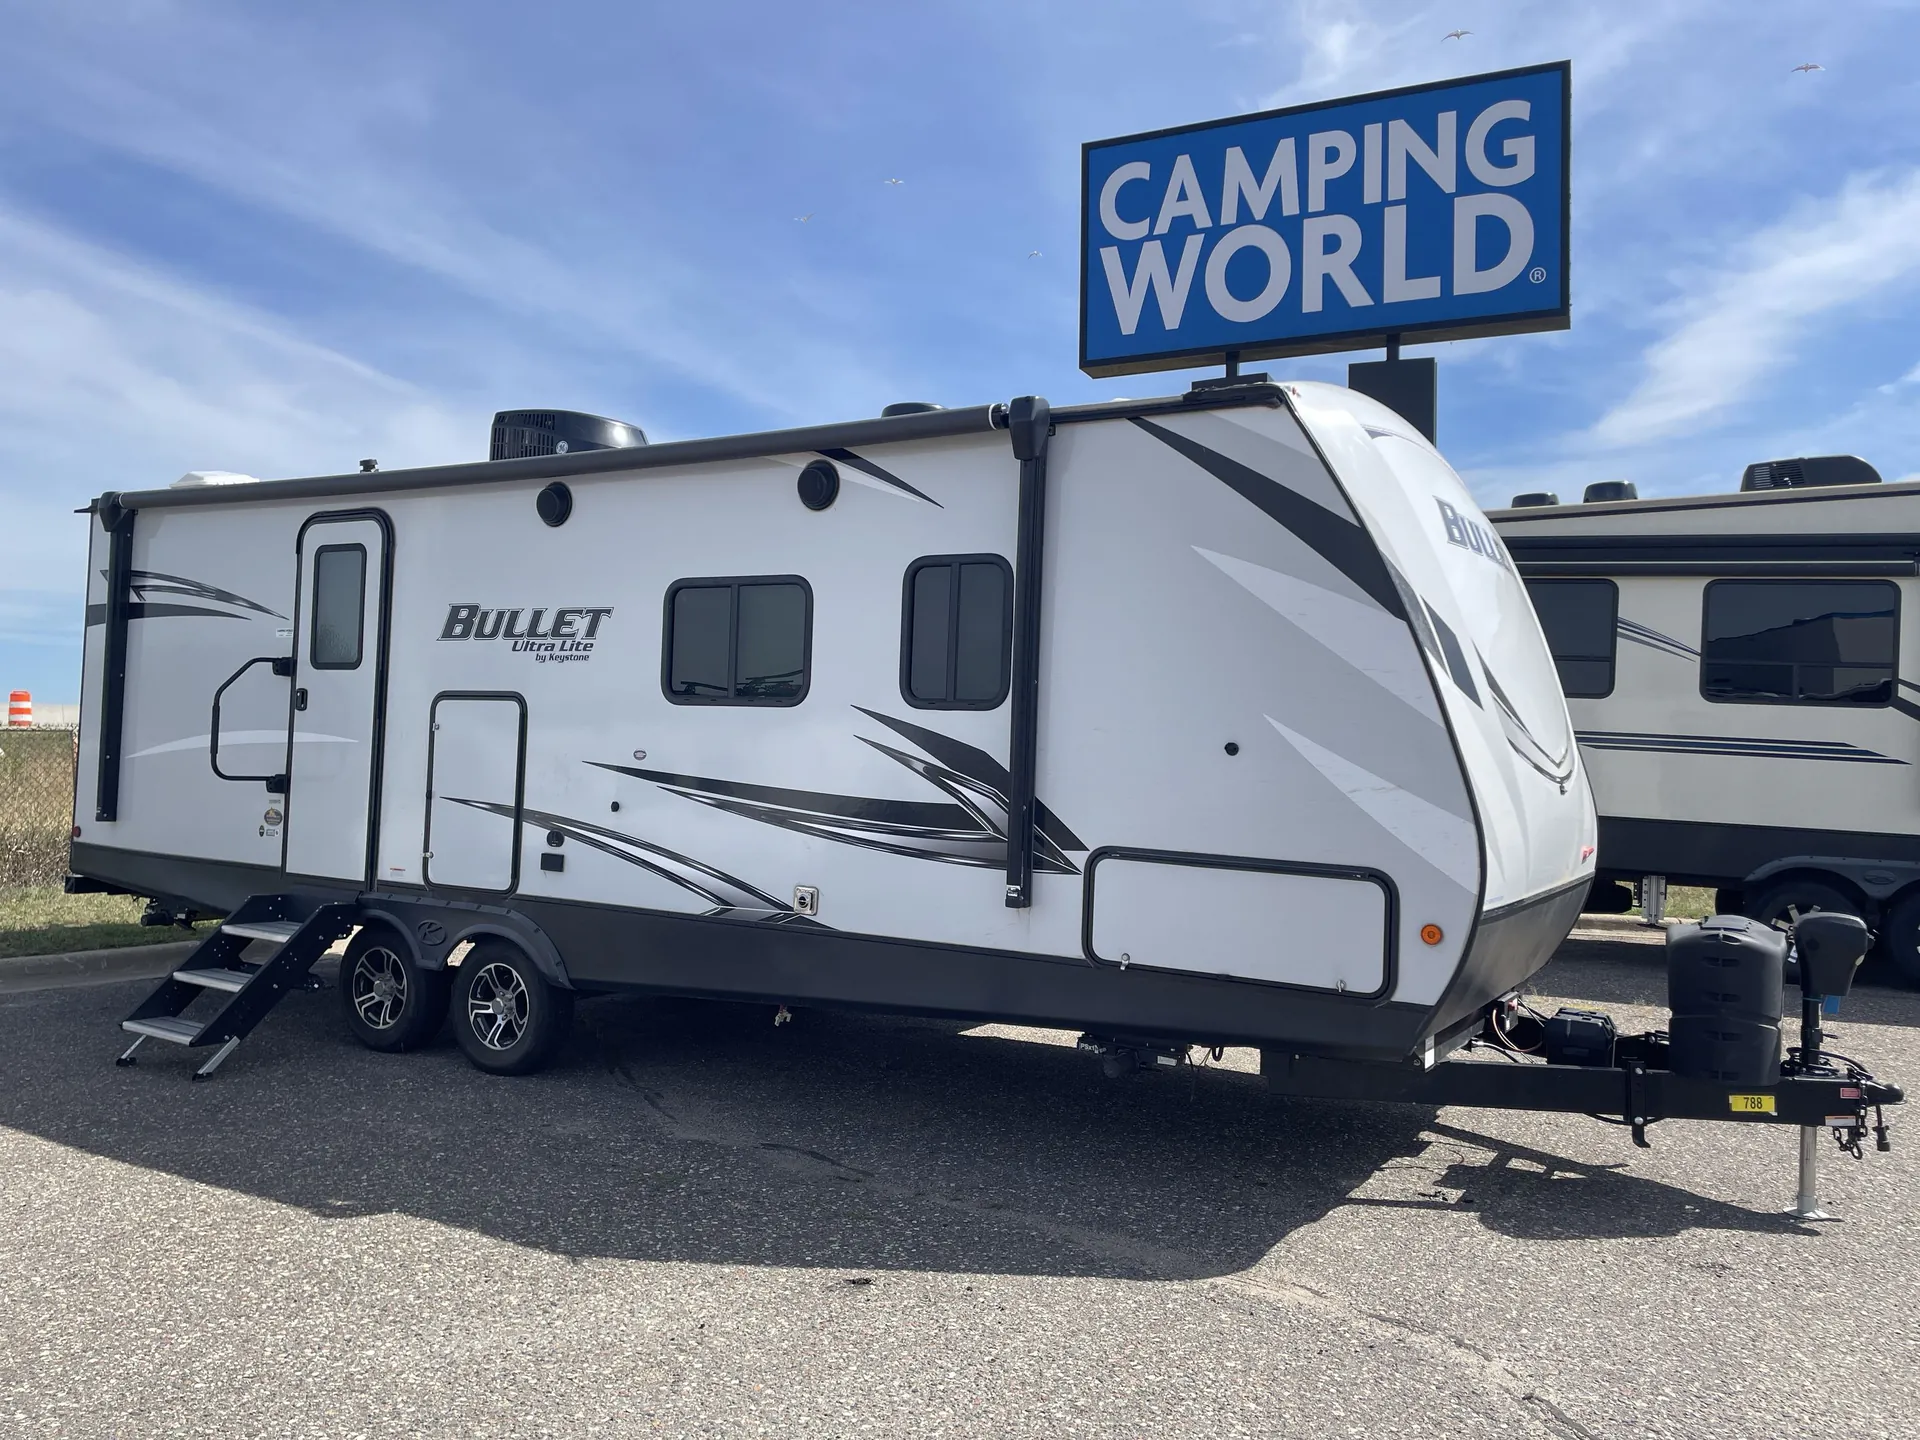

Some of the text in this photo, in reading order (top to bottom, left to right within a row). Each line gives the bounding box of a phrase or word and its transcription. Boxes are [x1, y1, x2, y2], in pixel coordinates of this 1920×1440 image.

[1099, 99, 1535, 240] CAMPING
[1100, 192, 1534, 335] WORLD
[436, 603, 614, 641] BULLET
[511, 640, 594, 652] Ultra Lite
[535, 653, 590, 663] by Keystone
[1743, 1096, 1763, 1109] 788
